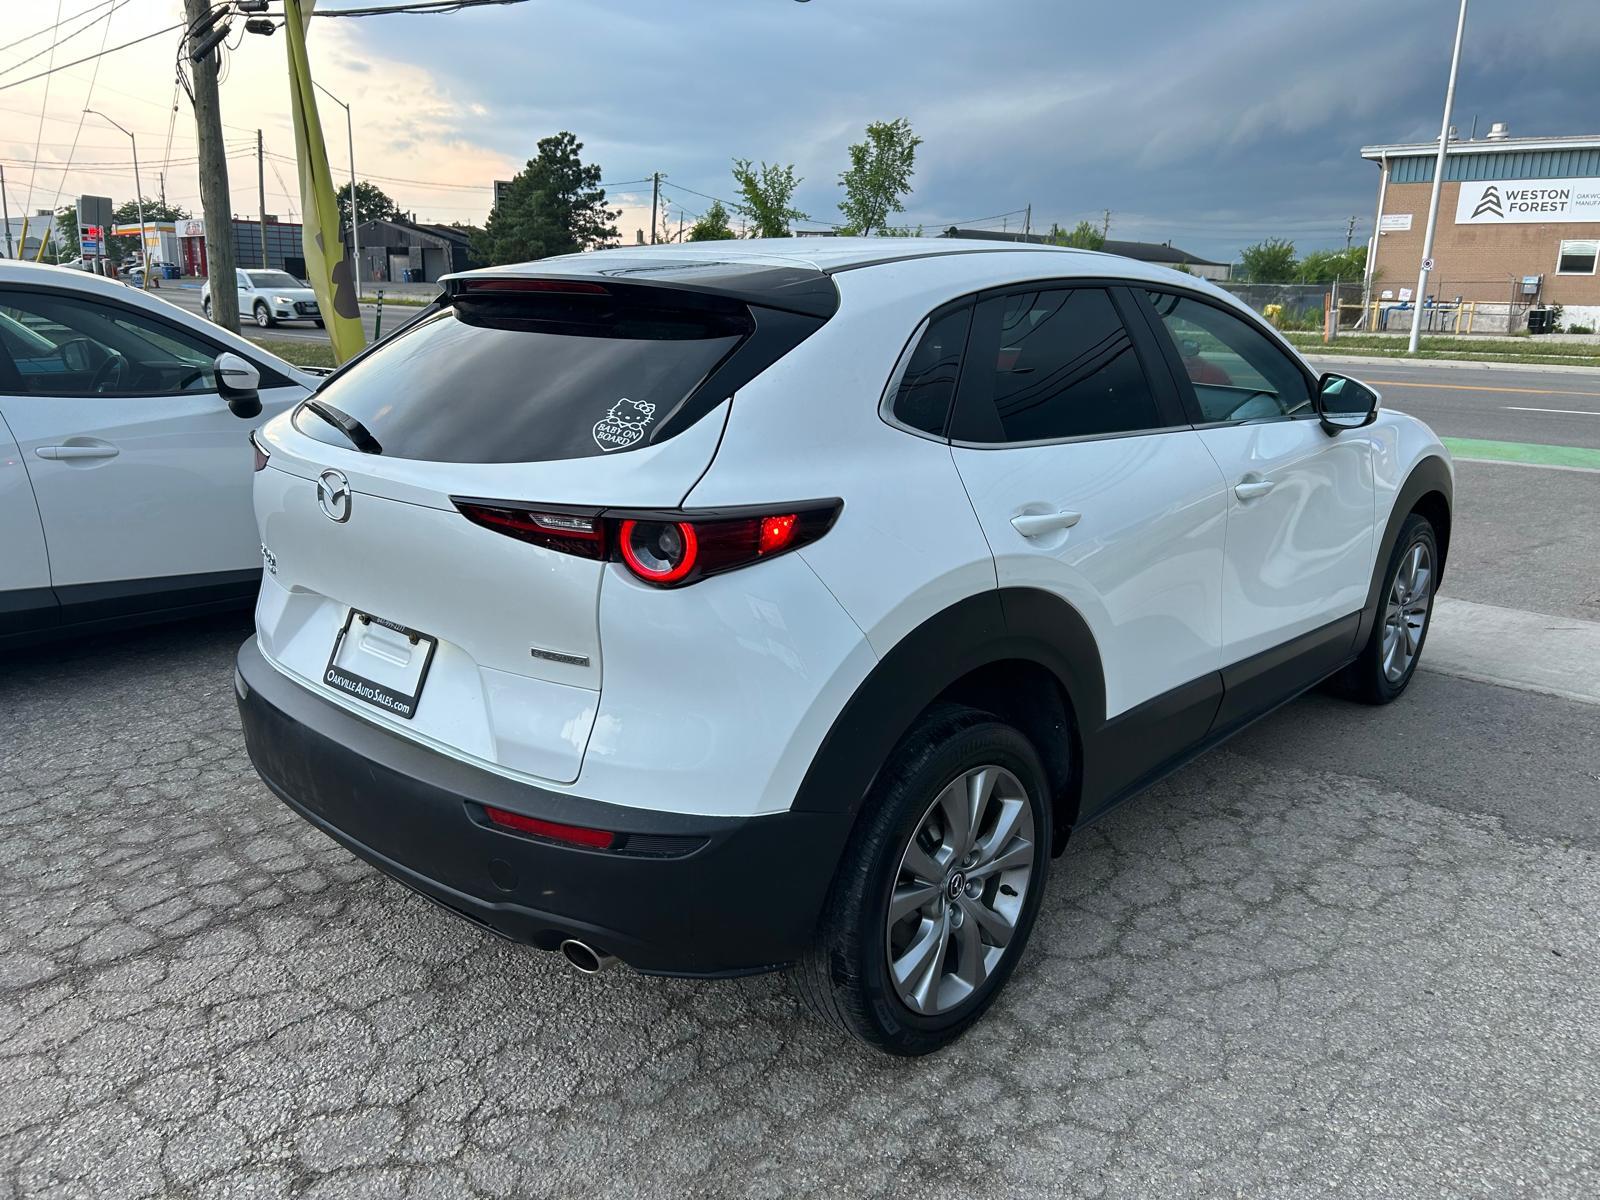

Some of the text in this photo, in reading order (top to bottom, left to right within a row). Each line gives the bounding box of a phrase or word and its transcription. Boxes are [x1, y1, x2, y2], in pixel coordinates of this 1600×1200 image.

[1506, 189, 1570, 200] WESTON
[1509, 201, 1568, 212] FOREST
[598, 424, 640, 439] BABY ON
[597, 432, 630, 445] BOARD
